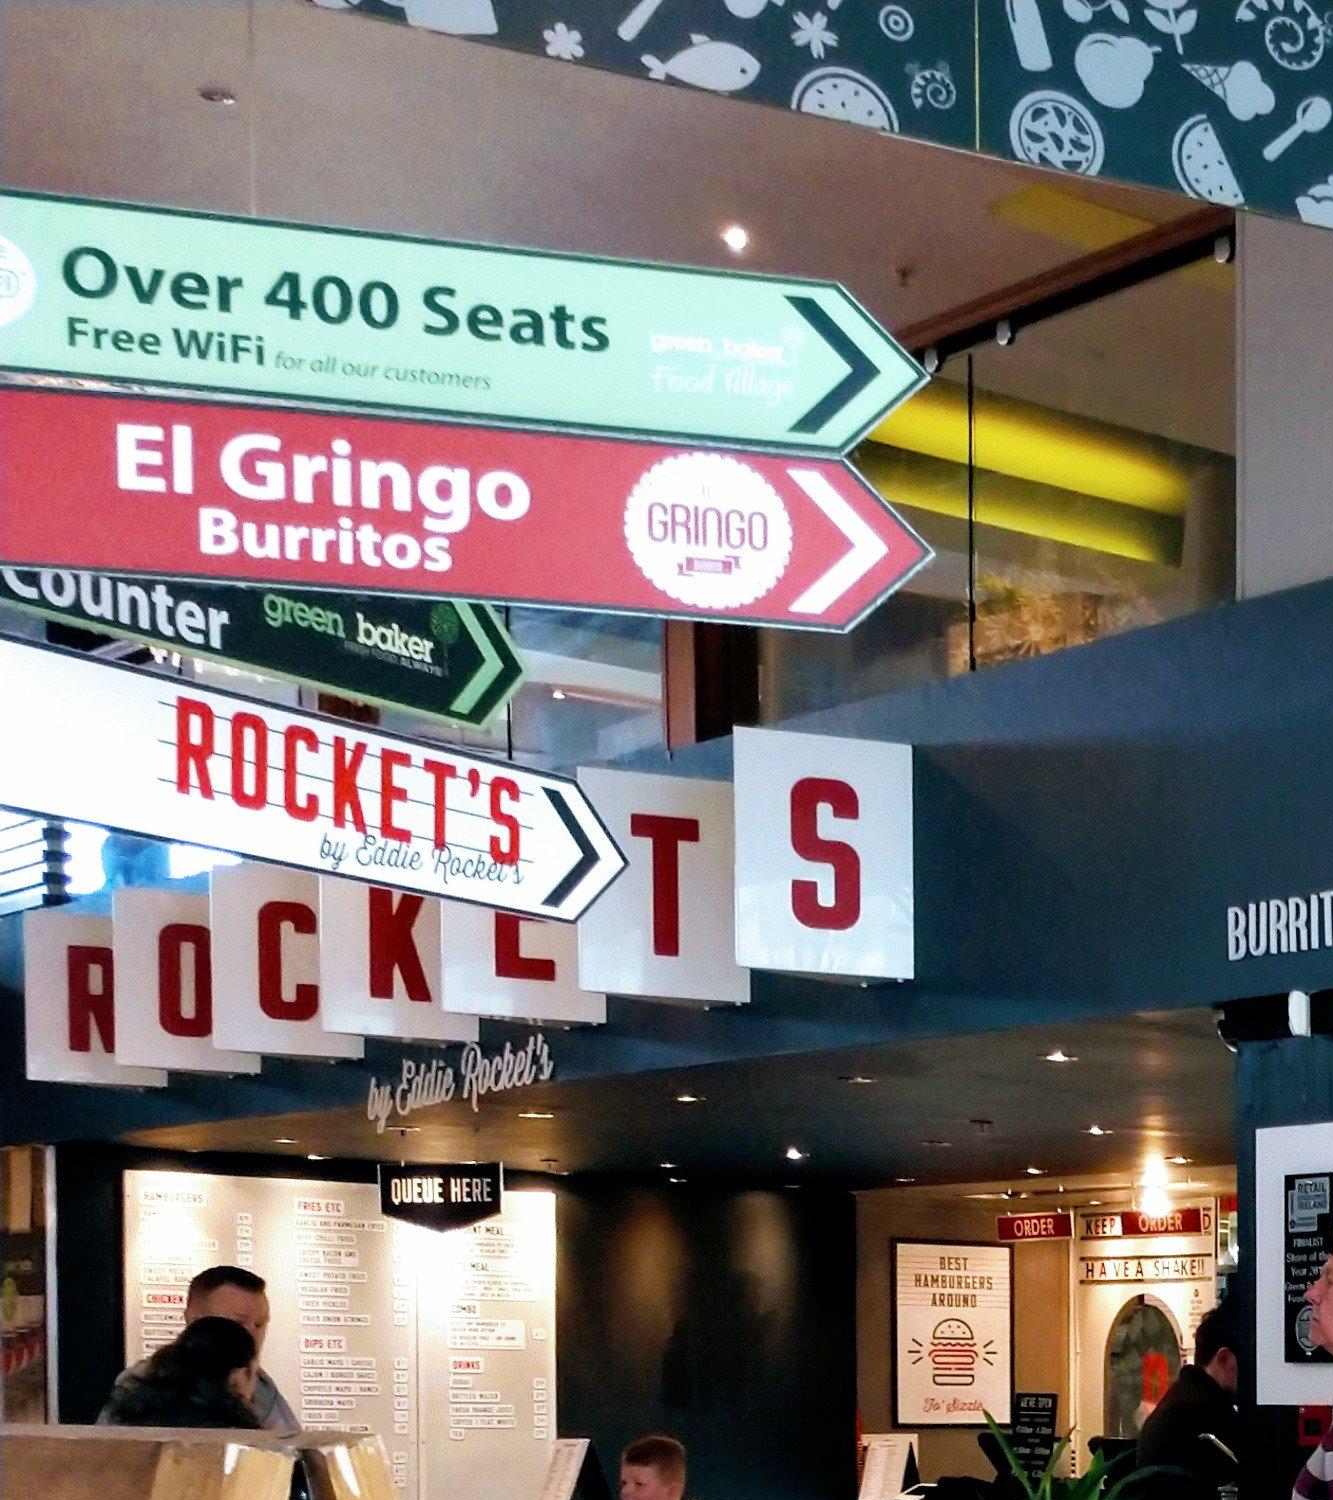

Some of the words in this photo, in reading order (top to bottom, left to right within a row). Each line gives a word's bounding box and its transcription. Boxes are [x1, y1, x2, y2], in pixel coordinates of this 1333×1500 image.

[62, 246, 242, 313] Over
[264, 271, 400, 330] 400
[422, 285, 610, 352] Seats
[67, 316, 161, 356] Free
[174, 327, 265, 366] WiFi
[275, 350, 306, 371] for
[310, 355, 338, 375] all
[342, 361, 378, 379] our
[384, 365, 492, 391] customers
[651, 364, 715, 394] Food
[724, 365, 796, 408] Village
[116, 423, 192, 494] El
[221, 434, 532, 532] Gringo
[199, 509, 453, 573] Burritos
[648, 502, 768, 551] GRINGO
[2, 567, 230, 650] Counter
[263, 594, 345, 639] green
[356, 612, 434, 663] baker
[176, 695, 522, 866] ROCKET'S
[320, 833, 349, 870] by
[355, 834, 423, 870] Eddie
[432, 844, 524, 884] Rocket's
[367, 1077, 393, 1134] by
[396, 1059, 456, 1116] Eddie
[461, 1034, 554, 1112] Rocket's
[391, 1177, 444, 1204] QUEUE
[451, 1178, 493, 1203] HERE
[1297, 1182, 1325, 1194] RETAIL
[1014, 1218, 1055, 1237] ORDER
[1085, 1217, 1115, 1235] KEEP
[1138, 1212, 1183, 1232] ORDER
[914, 1274, 994, 1290] HAMBURGERS
[939, 1256, 969, 1271] BEST
[931, 1293, 978, 1308] AROUND
